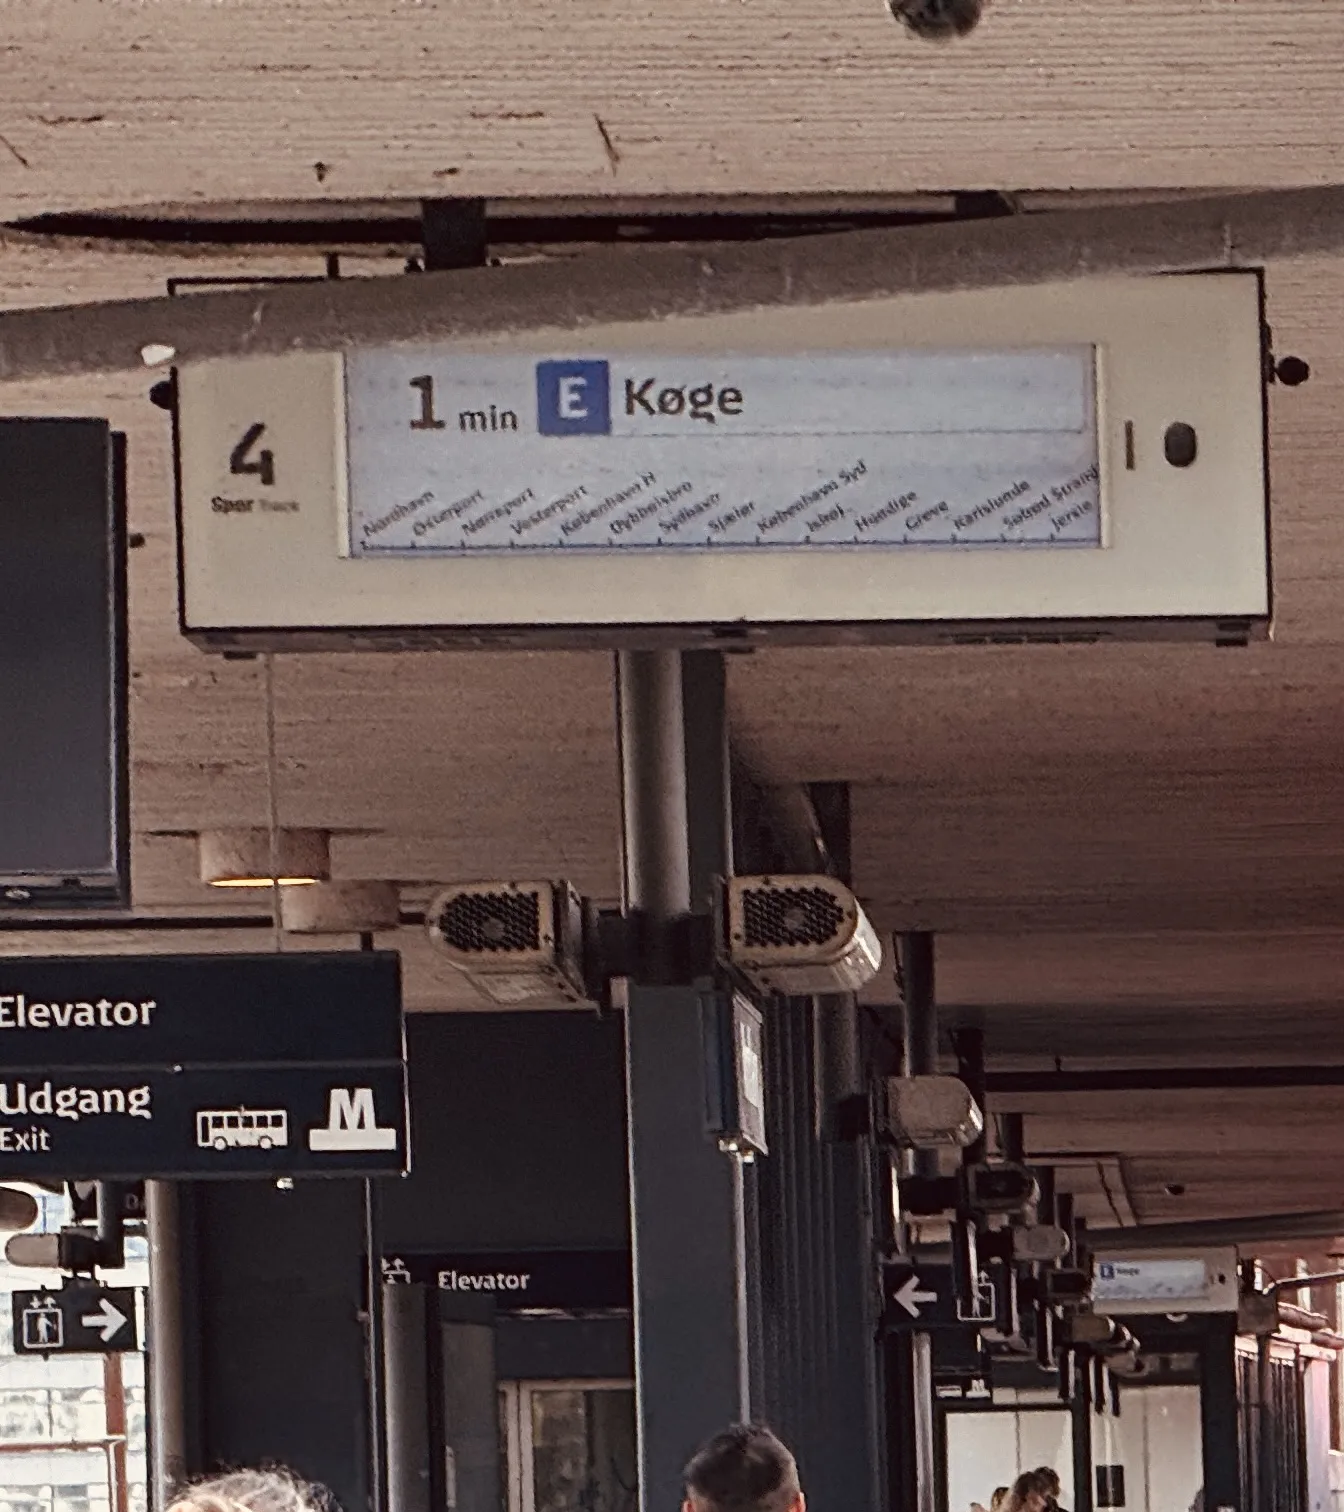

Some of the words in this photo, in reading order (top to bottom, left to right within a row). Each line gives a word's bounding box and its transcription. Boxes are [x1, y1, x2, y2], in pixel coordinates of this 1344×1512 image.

[409, 375, 446, 430] 1
[458, 404, 519, 432] min
[557, 376, 588, 419] E
[624, 377, 744, 425] Køge
[230, 422, 275, 485] 4
[0, 994, 156, 1029] Elevator
[0, 1081, 152, 1121] Udgang
[0, 1125, 51, 1152] Exit
[438, 1270, 531, 1291] Elevator
